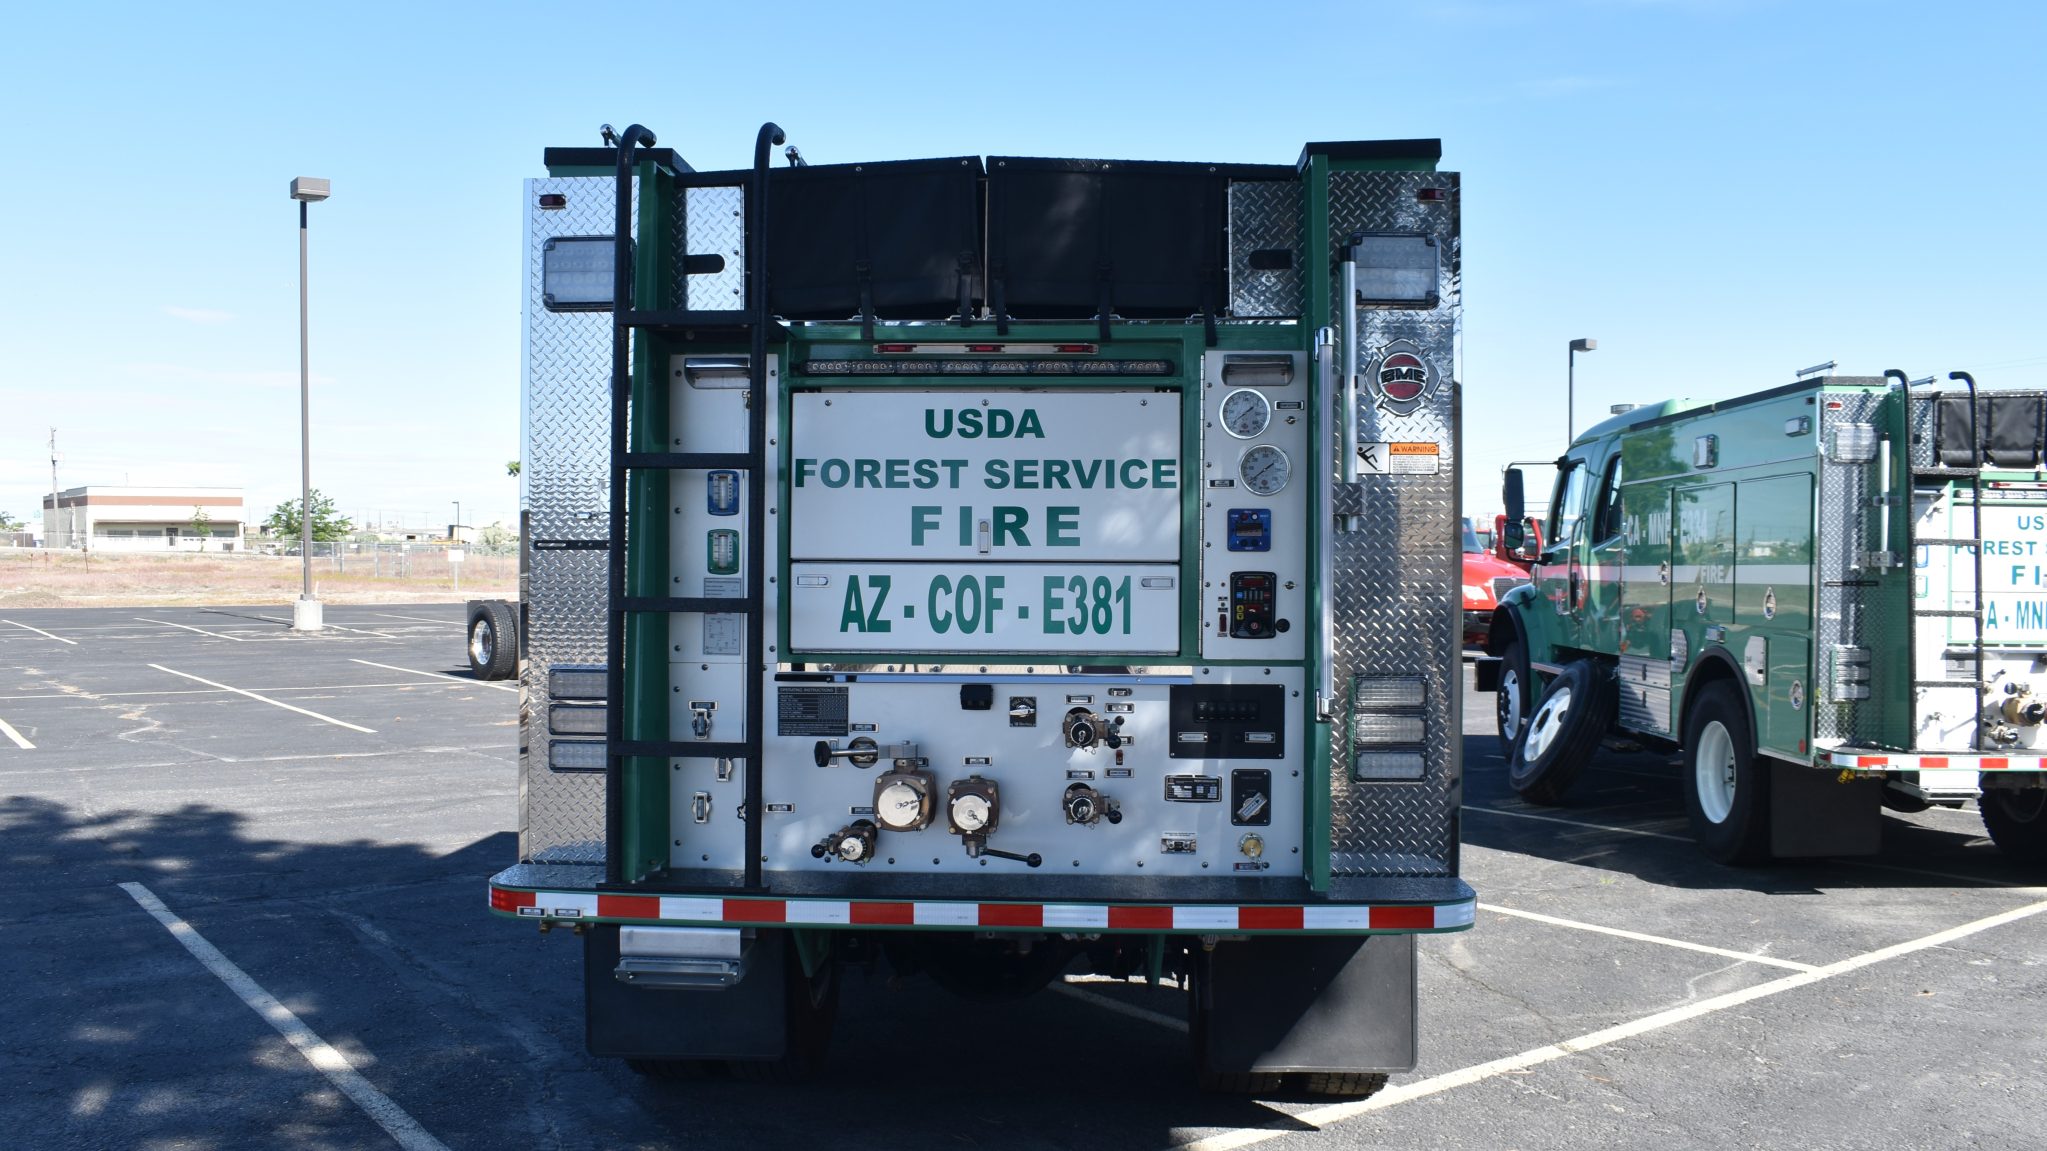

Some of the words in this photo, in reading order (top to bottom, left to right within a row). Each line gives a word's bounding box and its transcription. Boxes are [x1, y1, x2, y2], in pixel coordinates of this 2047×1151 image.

[1381, 367, 1426, 383] BME
[924, 408, 1046, 439] USDA
[1401, 445, 1437, 453] WARNING
[794, 458, 969, 489] FOREST
[983, 459, 1177, 490] SERVICE
[910, 505, 1082, 547] FIRE
[1626, 514, 1641, 546] CA
[1700, 565, 1727, 584] FIRE
[839, 574, 892, 633] AZ
[927, 573, 1005, 634] COF
[1042, 574, 1133, 635] E381
